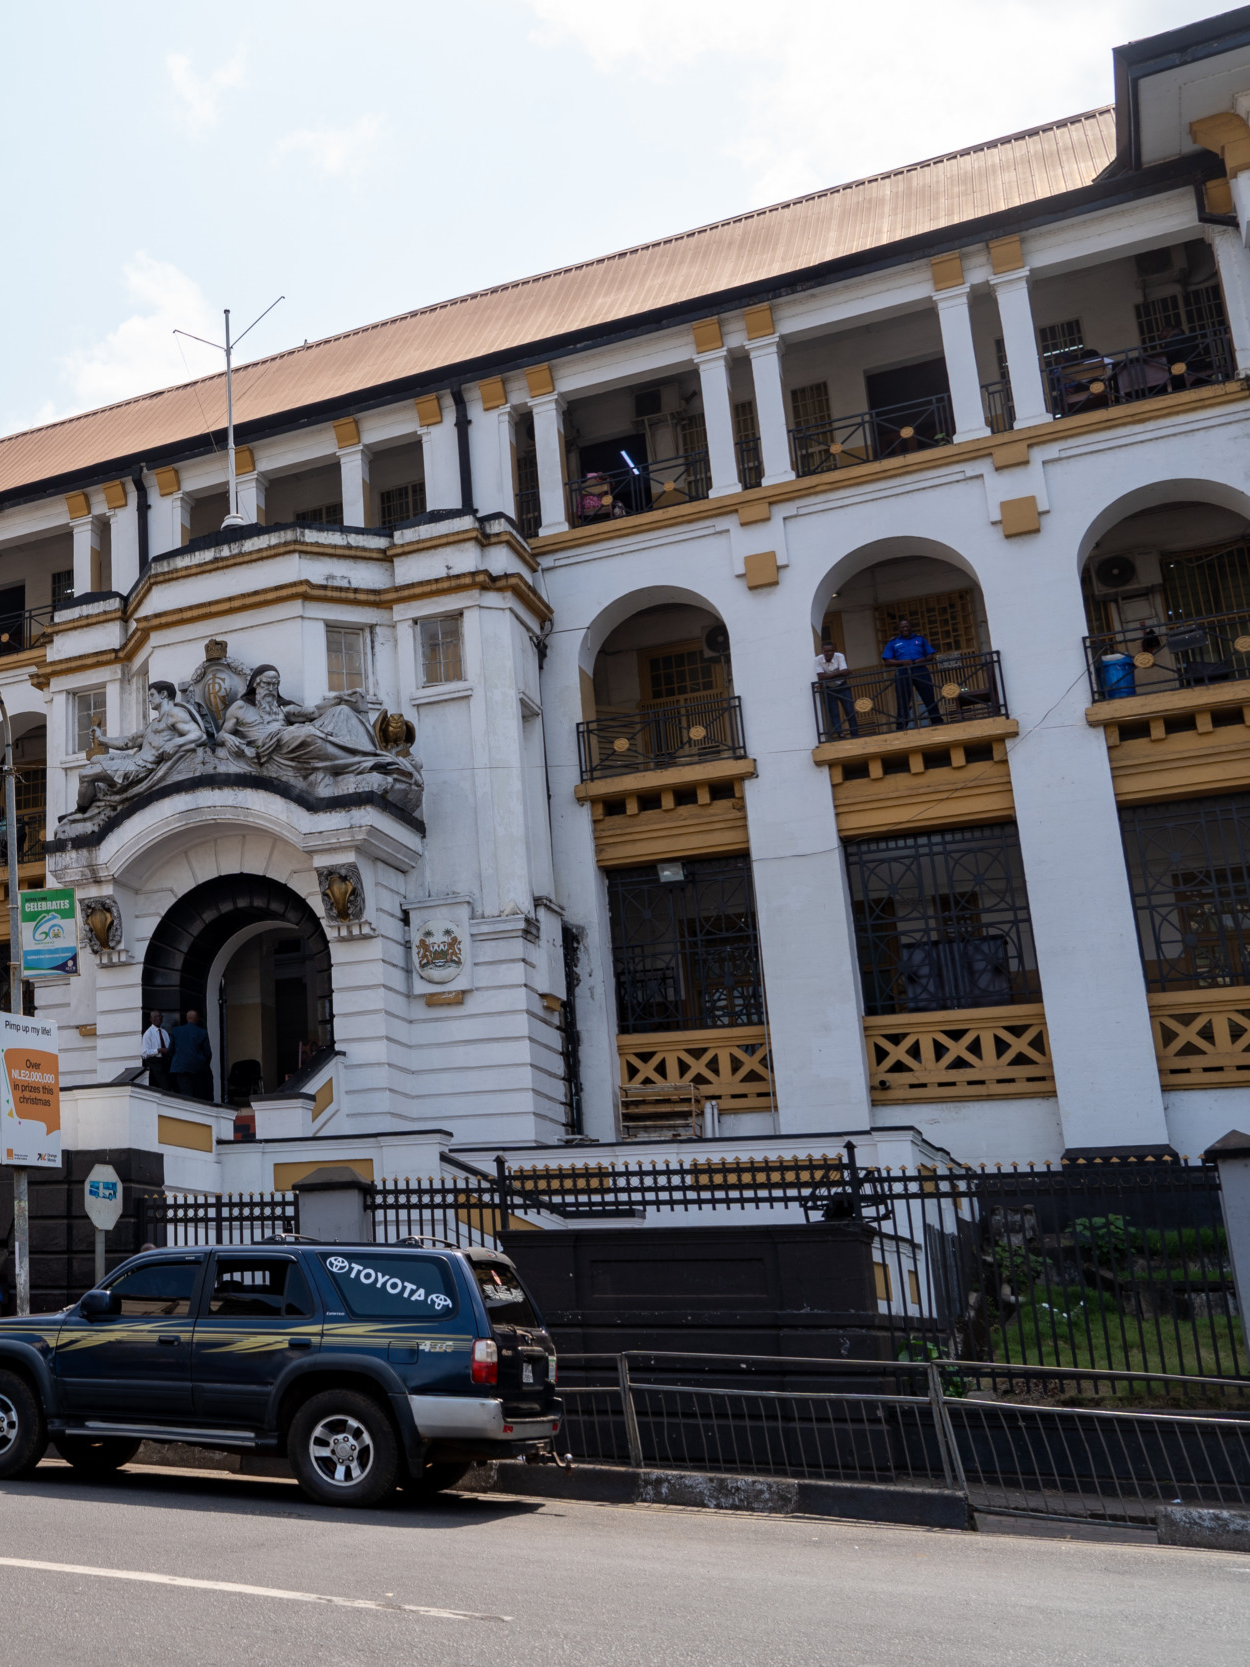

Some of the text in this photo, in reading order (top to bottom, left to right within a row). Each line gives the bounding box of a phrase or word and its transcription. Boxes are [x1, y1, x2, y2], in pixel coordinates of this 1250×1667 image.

[25, 900, 70, 912] CELEBRATES
[5, 1020, 52, 1036] Pimp up my life!
[25, 1059, 41, 1070] Over
[11, 1069, 55, 1084] NLE2,000,000
[13, 1081, 54, 1096] in prizes this
[19, 1094, 51, 1107] christmas
[349, 1262, 426, 1301] TOYOTA
